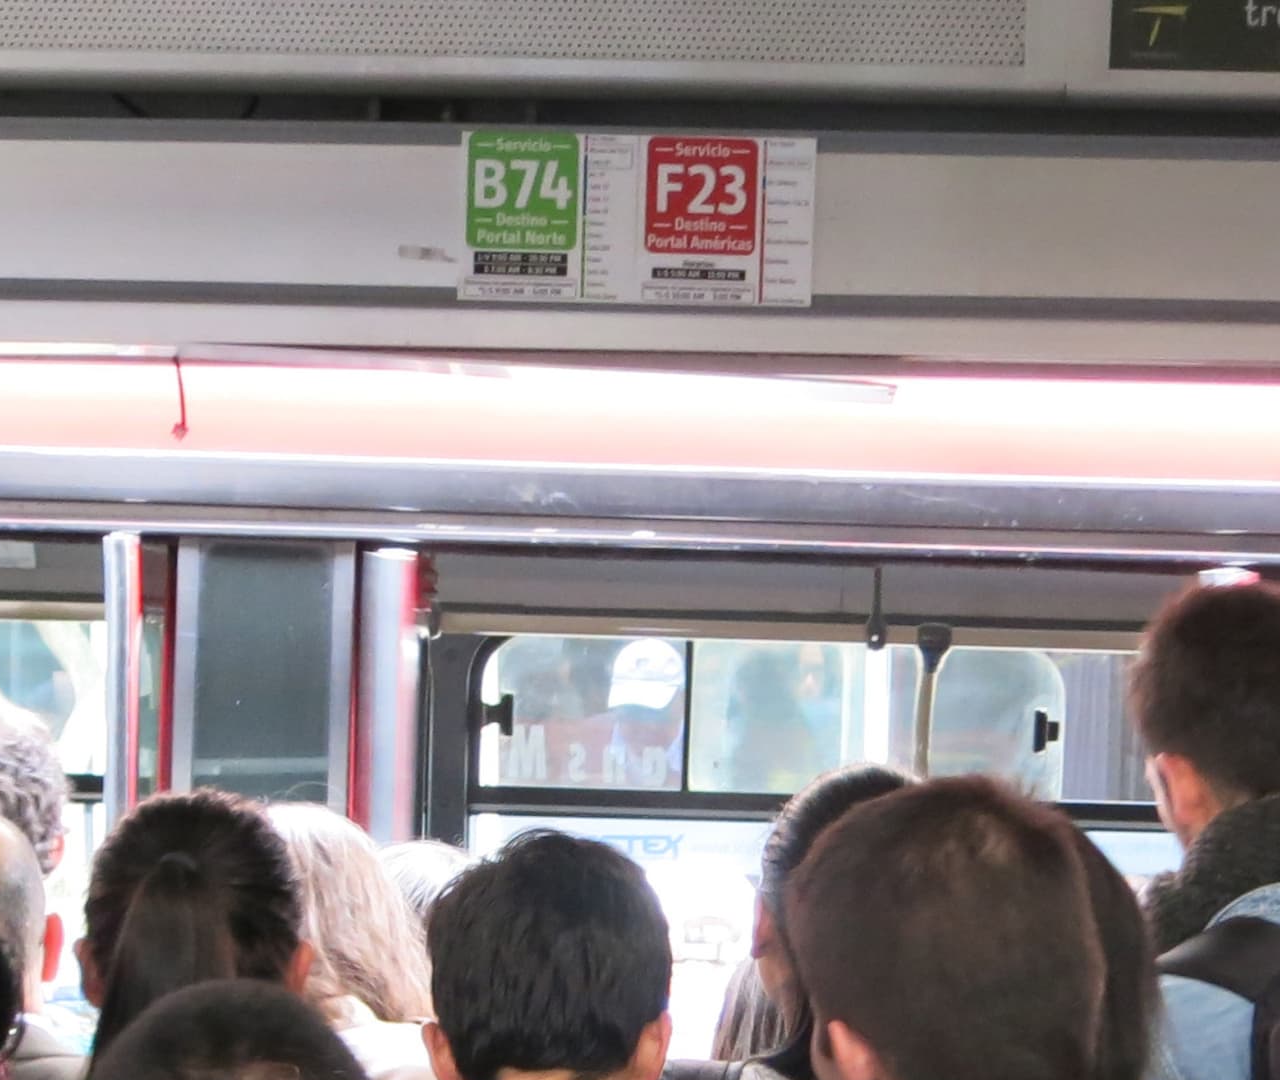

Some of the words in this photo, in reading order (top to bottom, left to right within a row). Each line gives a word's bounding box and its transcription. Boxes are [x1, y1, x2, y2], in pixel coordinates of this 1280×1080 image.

[495, 137, 552, 153] Servicio
[675, 142, 731, 158] Servicio
[473, 159, 573, 210] B74
[655, 163, 748, 216] F23
[496, 212, 549, 227] Destino
[675, 217, 727, 233] Destino
[476, 229, 521, 245] Portal
[525, 230, 567, 246] Norte
[647, 233, 688, 250] Portal
[690, 234, 754, 252] Américas
